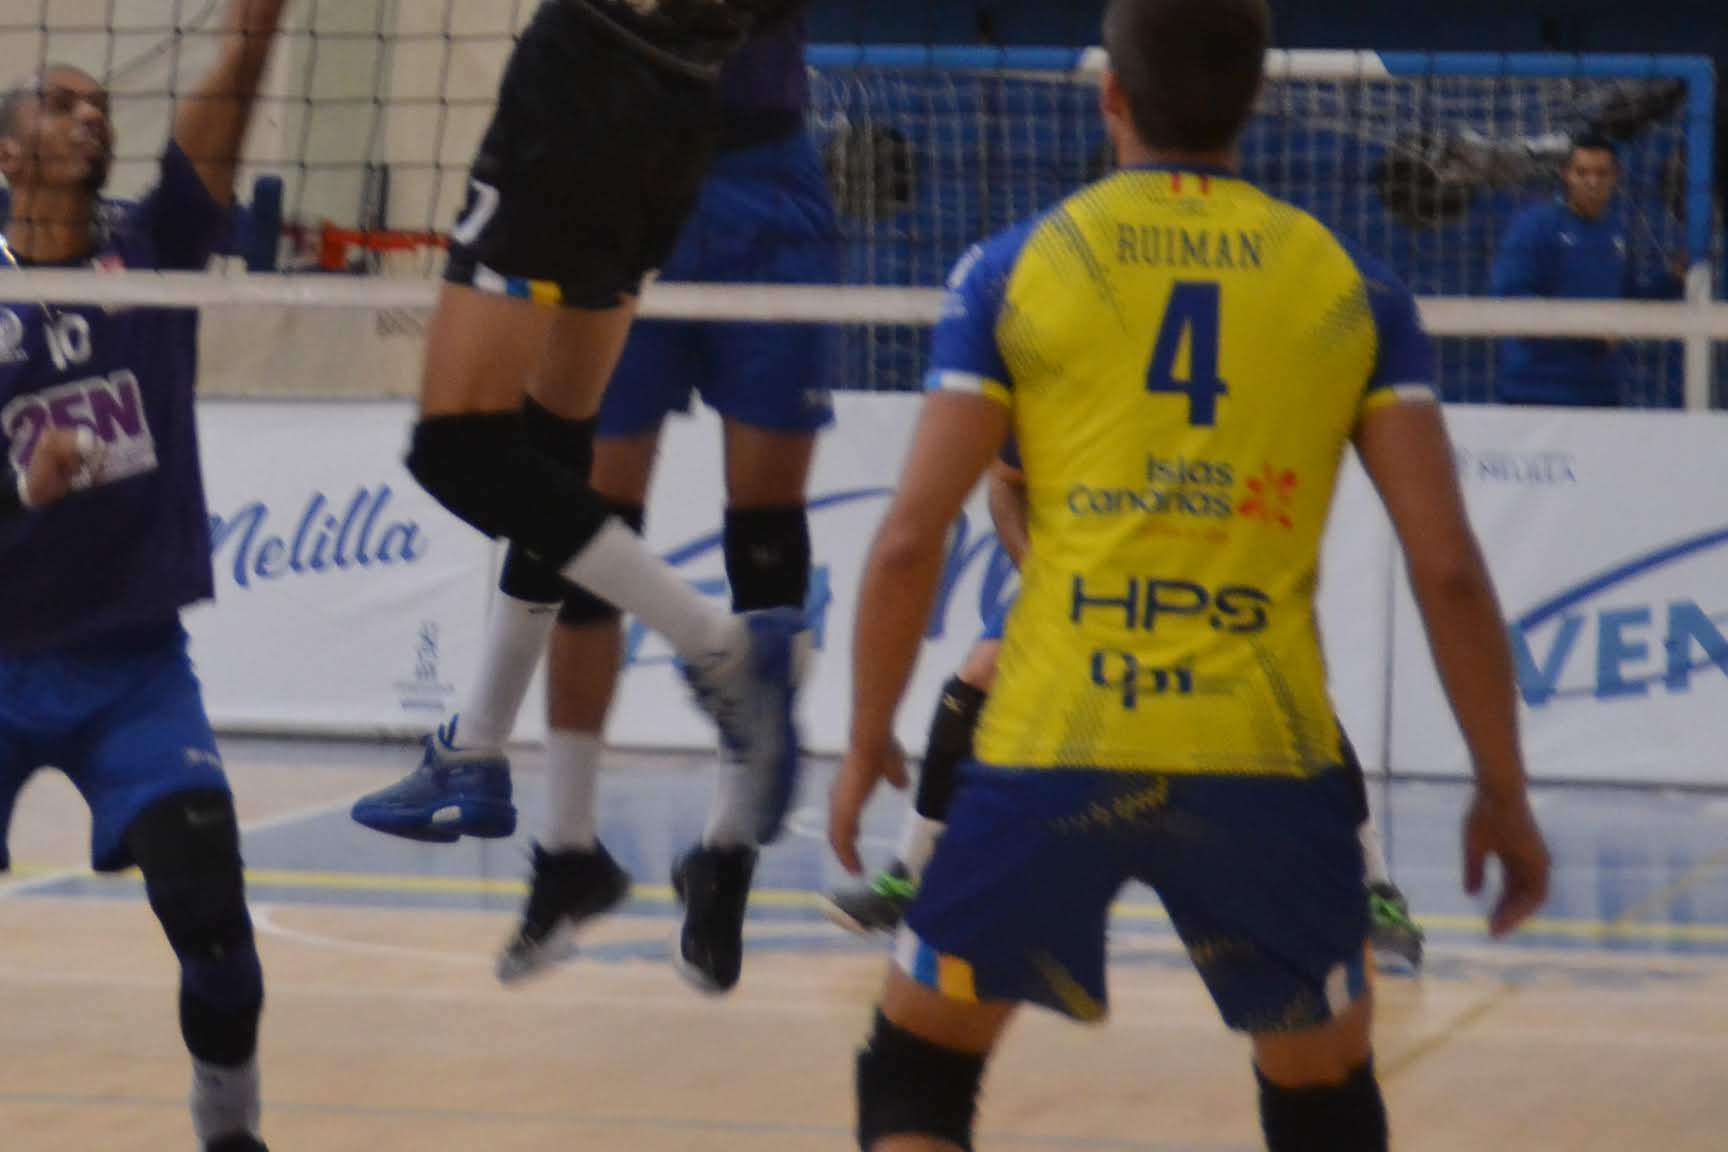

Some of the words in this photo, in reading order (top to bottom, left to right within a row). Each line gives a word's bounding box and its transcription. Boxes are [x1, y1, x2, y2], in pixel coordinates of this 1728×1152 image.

[1116, 223, 1264, 270] RUIMAN
[42, 311, 93, 372] 10
[1145, 281, 1229, 427] 4
[209, 483, 430, 589] Melilla
[1070, 574, 1271, 635] HPS
[1510, 598, 1728, 710] VEN
